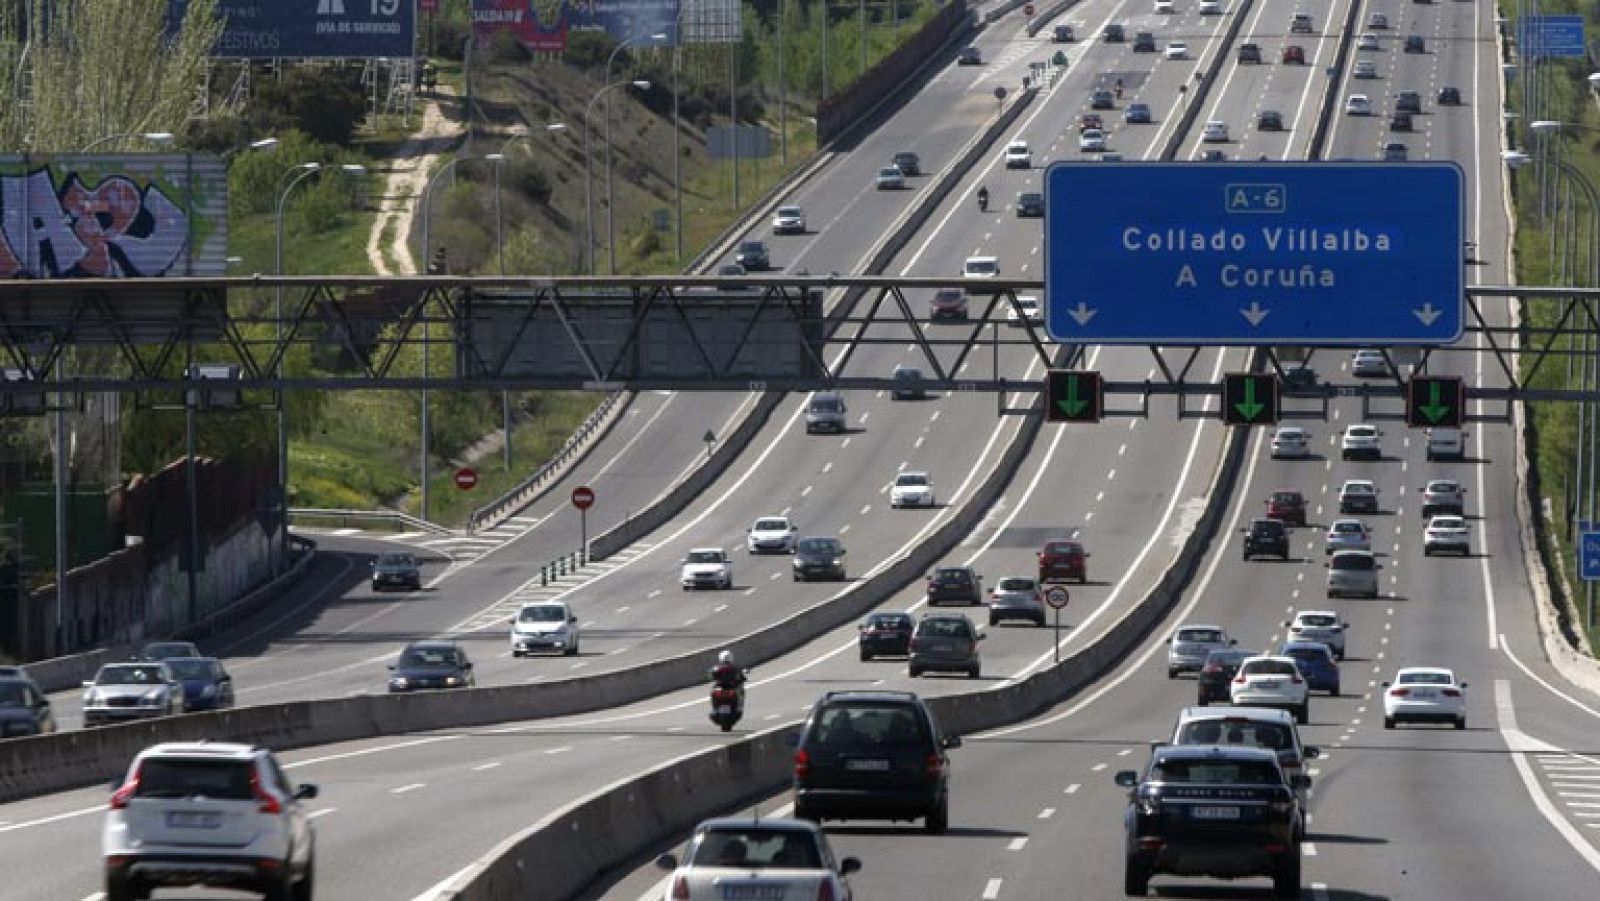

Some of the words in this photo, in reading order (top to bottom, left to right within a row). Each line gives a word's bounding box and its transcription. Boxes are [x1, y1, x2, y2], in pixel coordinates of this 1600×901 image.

[371, 0, 400, 15] 19
[1231, 189, 1280, 207] A-6
[1122, 227, 1246, 251] Collado
[1262, 227, 1391, 251] Villalba
[1175, 264, 1197, 287] A
[1220, 264, 1335, 287] Coruña
